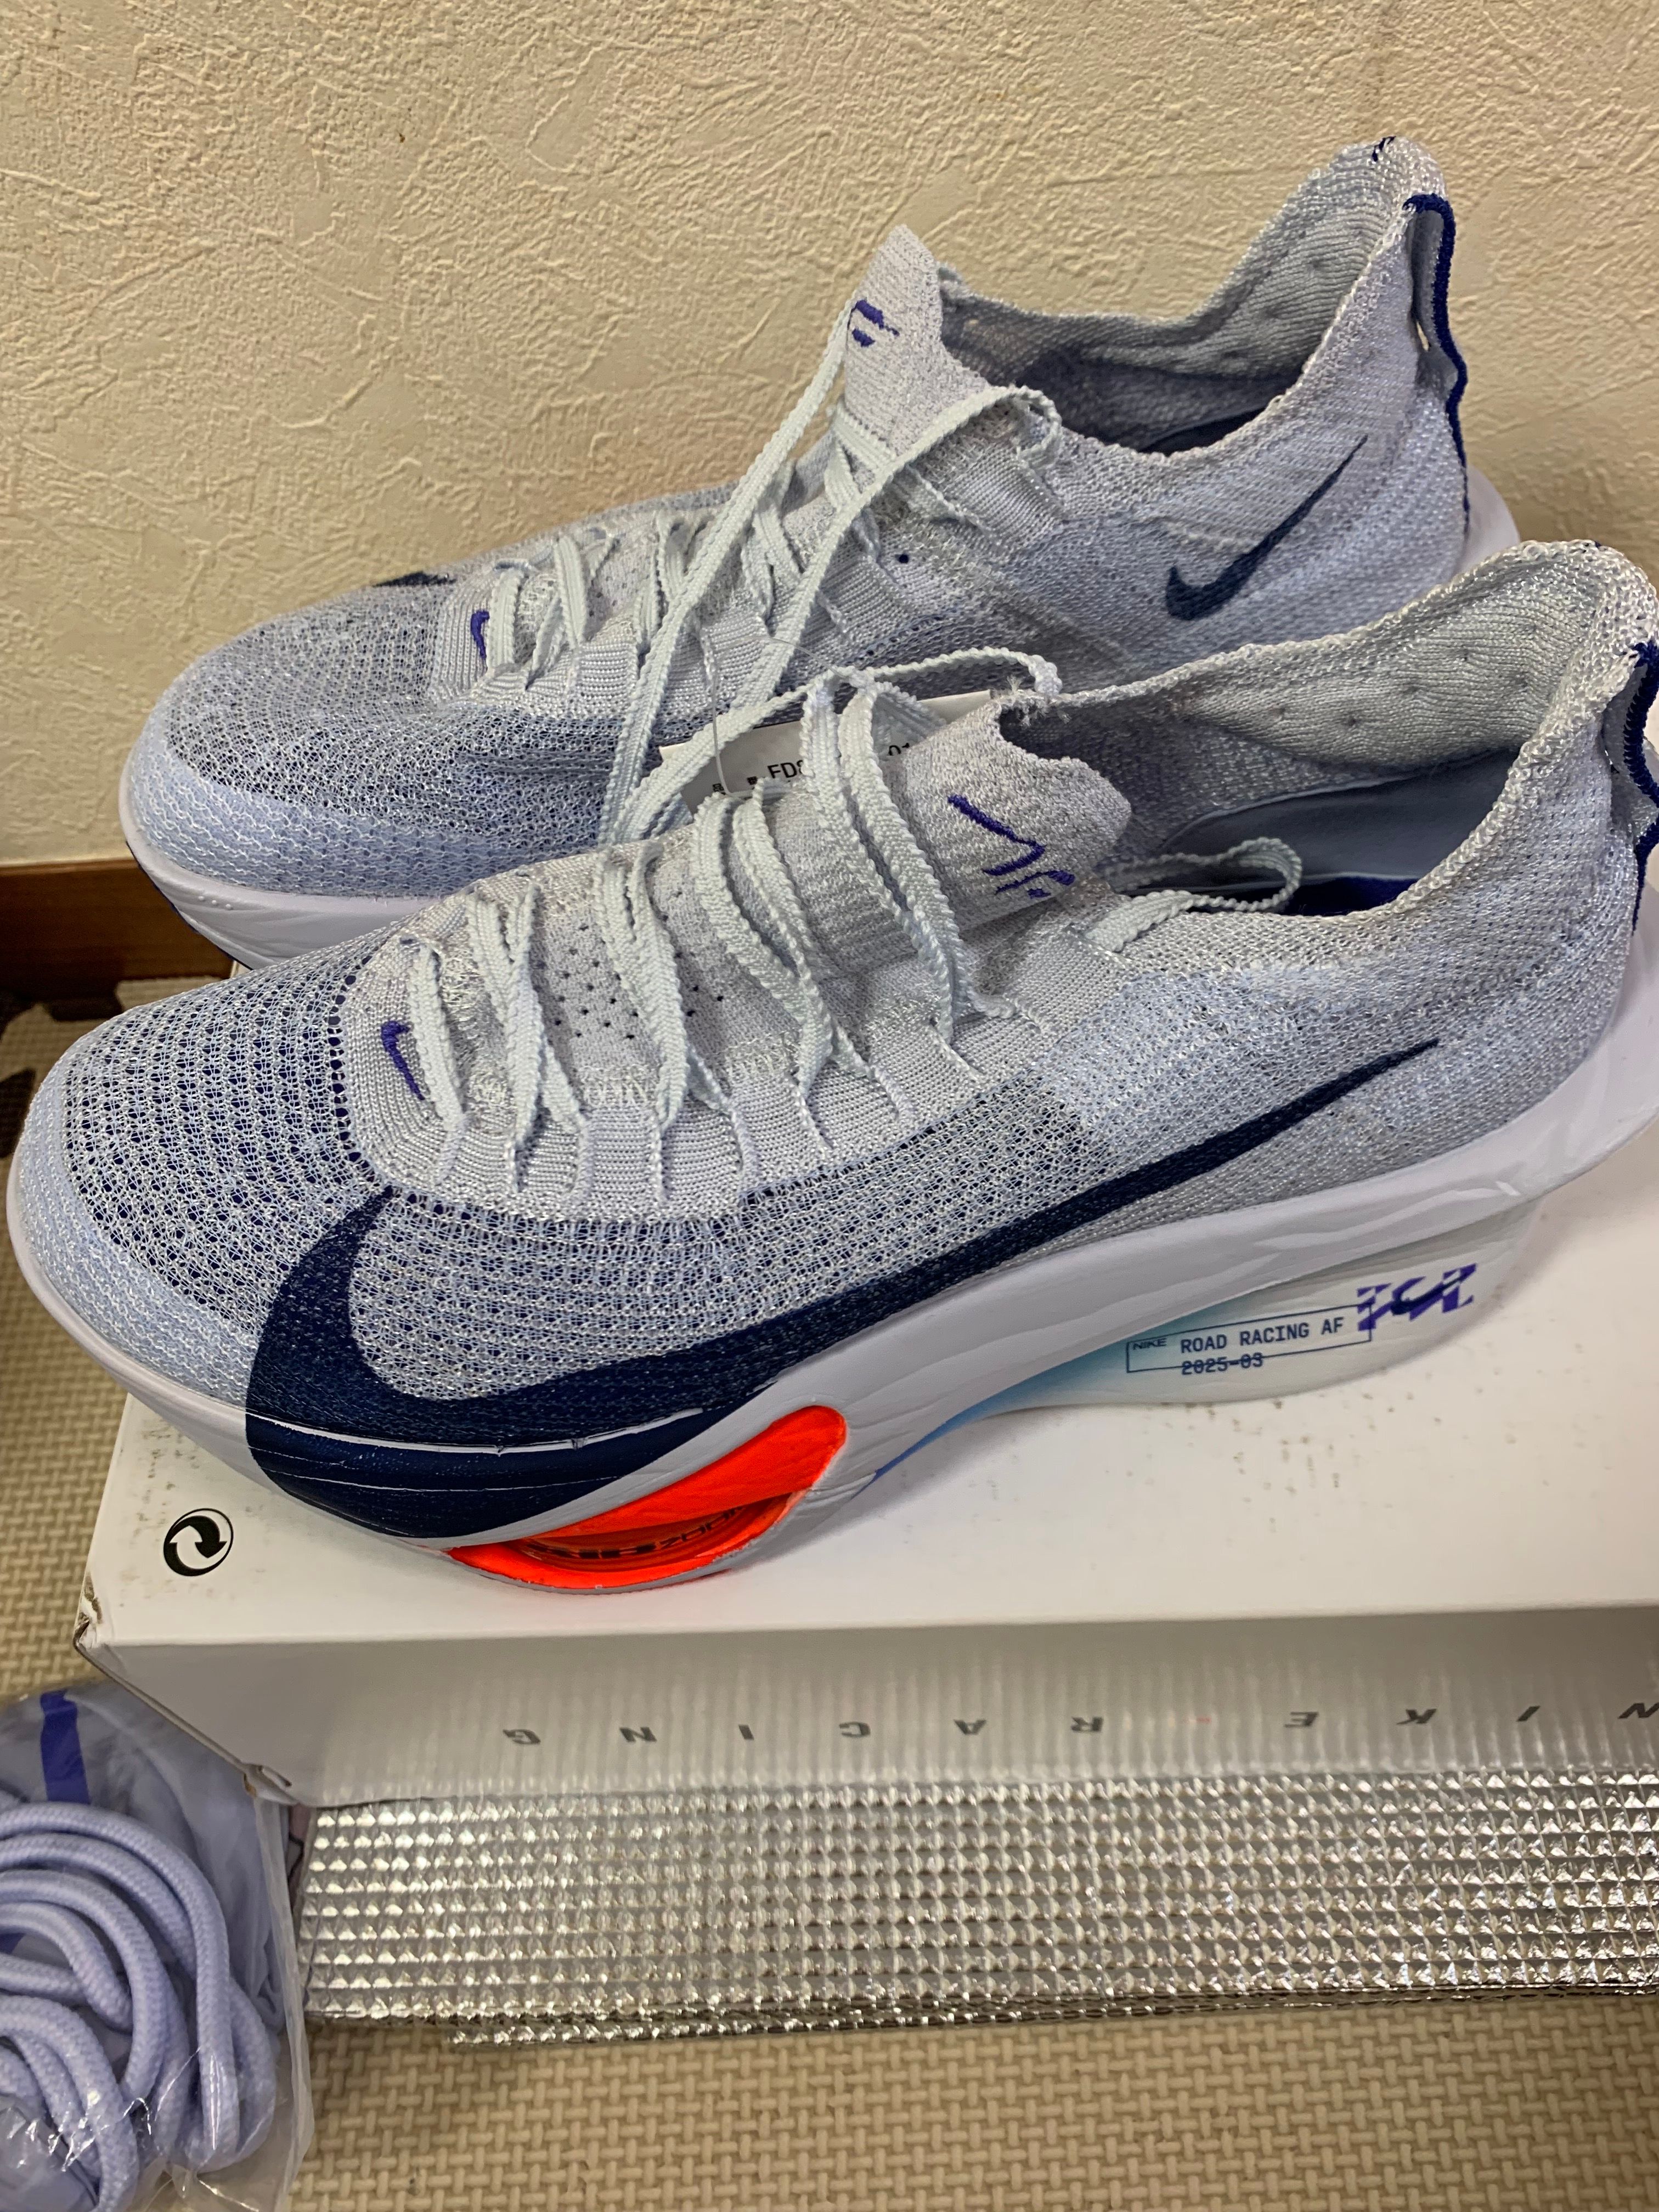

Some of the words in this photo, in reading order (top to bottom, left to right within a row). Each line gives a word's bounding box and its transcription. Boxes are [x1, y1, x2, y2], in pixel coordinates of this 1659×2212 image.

[1133, 1337, 1167, 1351] NIKE
[1181, 1334, 1227, 1353] ROAD
[1240, 1322, 1310, 1346] RACING
[1321, 1317, 1344, 1335] AF
[1181, 1352, 1264, 1375] 2025-03
